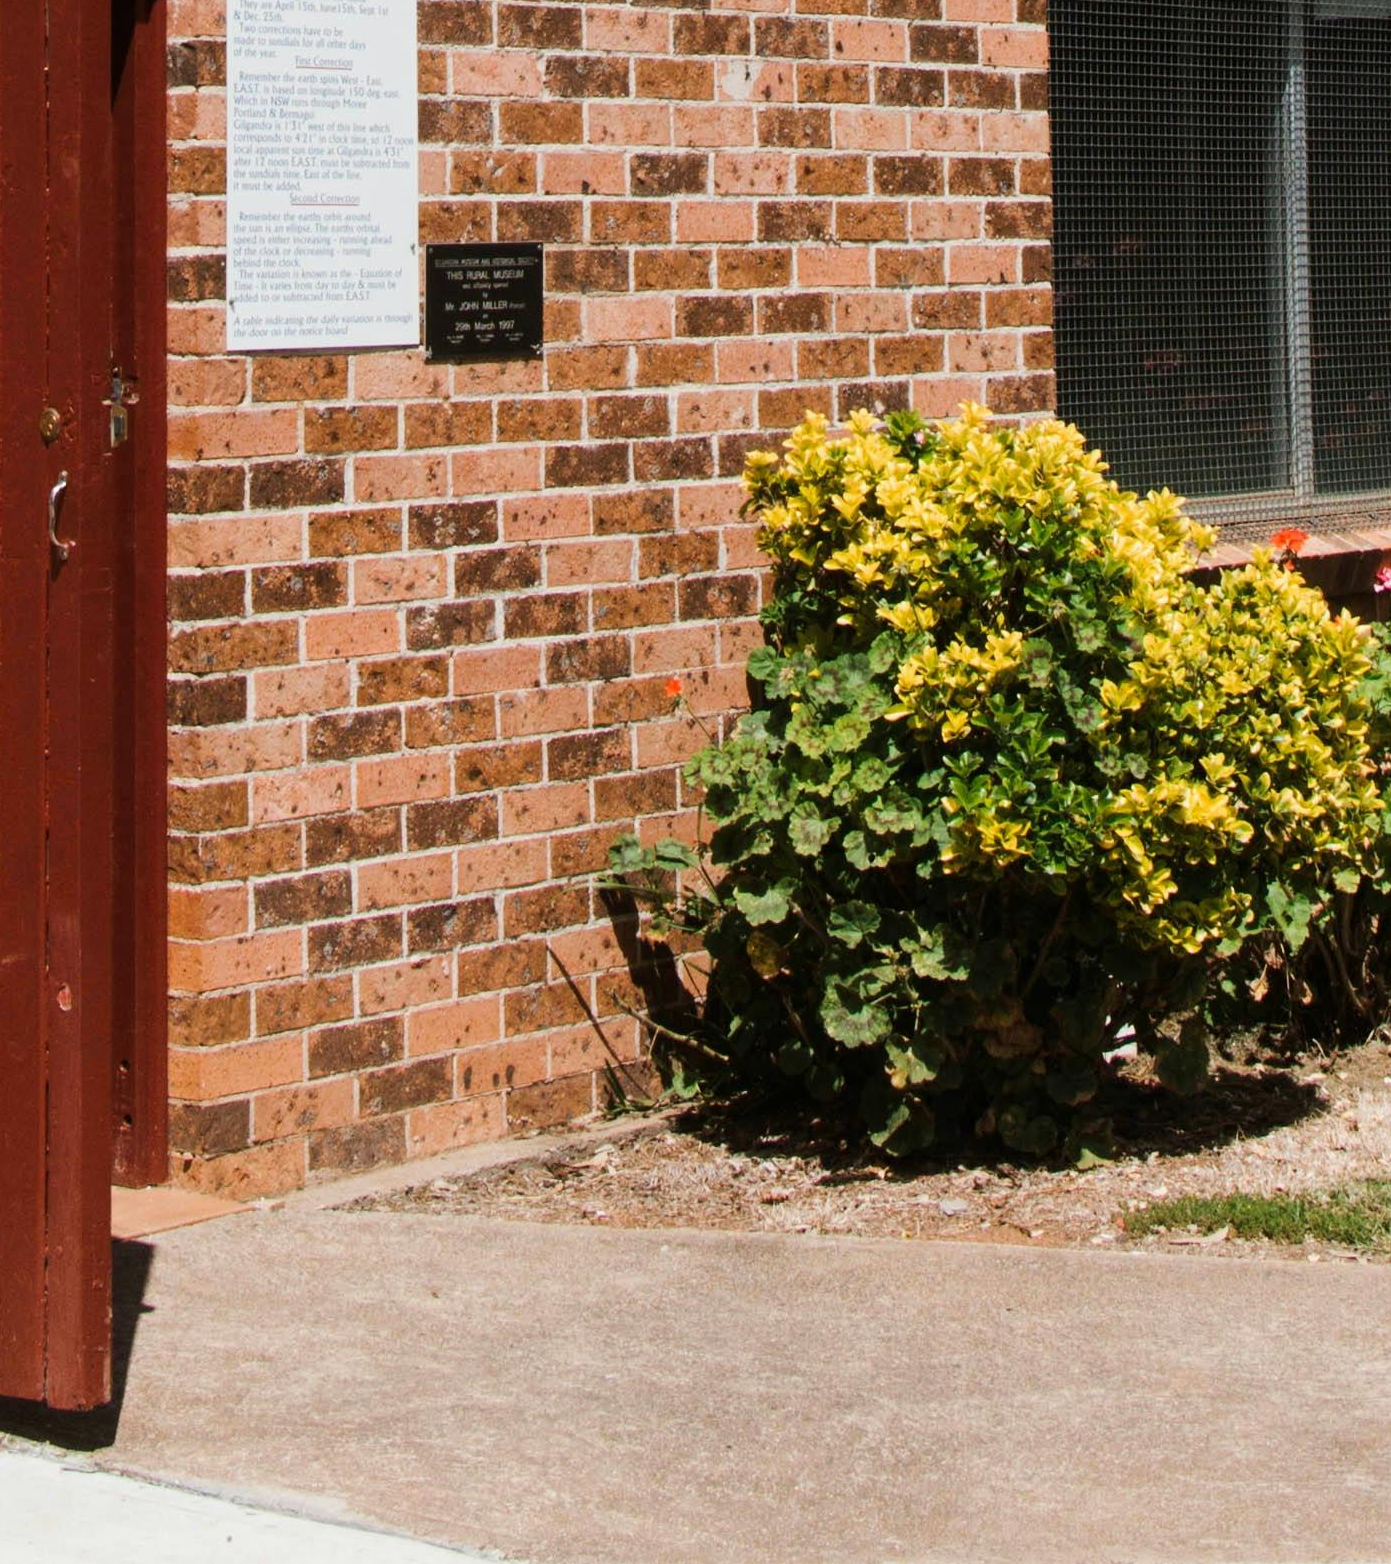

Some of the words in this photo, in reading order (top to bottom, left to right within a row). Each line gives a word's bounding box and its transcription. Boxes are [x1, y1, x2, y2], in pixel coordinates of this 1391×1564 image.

[275, 0, 294, 13] April
[234, 10, 240, 20] &
[240, 23, 256, 33] Two
[259, 23, 301, 35] corrections
[304, 25, 321, 35] have
[334, 26, 343, 36] be
[234, 33, 254, 44] made
[269, 35, 300, 46] sundials
[349, 39, 365, 52] days
[234, 46, 241, 56] of
[245, 47, 257, 57] the
[314, 57, 353, 68] Correction
[239, 70, 280, 82] Remember
[283, 72, 294, 82] the
[298, 73, 317, 83] earth
[273, 84, 294, 95] based
[349, 86, 363, 97] 150
[234, 95, 257, 106] Which
[271, 96, 289, 107] NSW
[234, 106, 266, 117] Portland
[269, 108, 276, 118] &
[234, 119, 272, 132] Gilgandra
[234, 145, 252, 154] local
[290, 193, 317, 203] Second
[320, 194, 360, 204] Correction
[240, 211, 281, 221] Remember
[284, 211, 294, 221] the
[245, 246, 257, 256] the
[234, 258, 261, 268] behind
[264, 257, 276, 267] the
[240, 269, 254, 279] The
[447, 271, 463, 280] THIS
[466, 270, 490, 280] RURAL
[493, 269, 524, 279] MUSEUM
[315, 279, 330, 292] day
[342, 279, 355, 292] day
[459, 301, 479, 311] JOHN
[482, 300, 508, 310] MILLER
[474, 321, 495, 330] March
[499, 320, 515, 330] 1997
